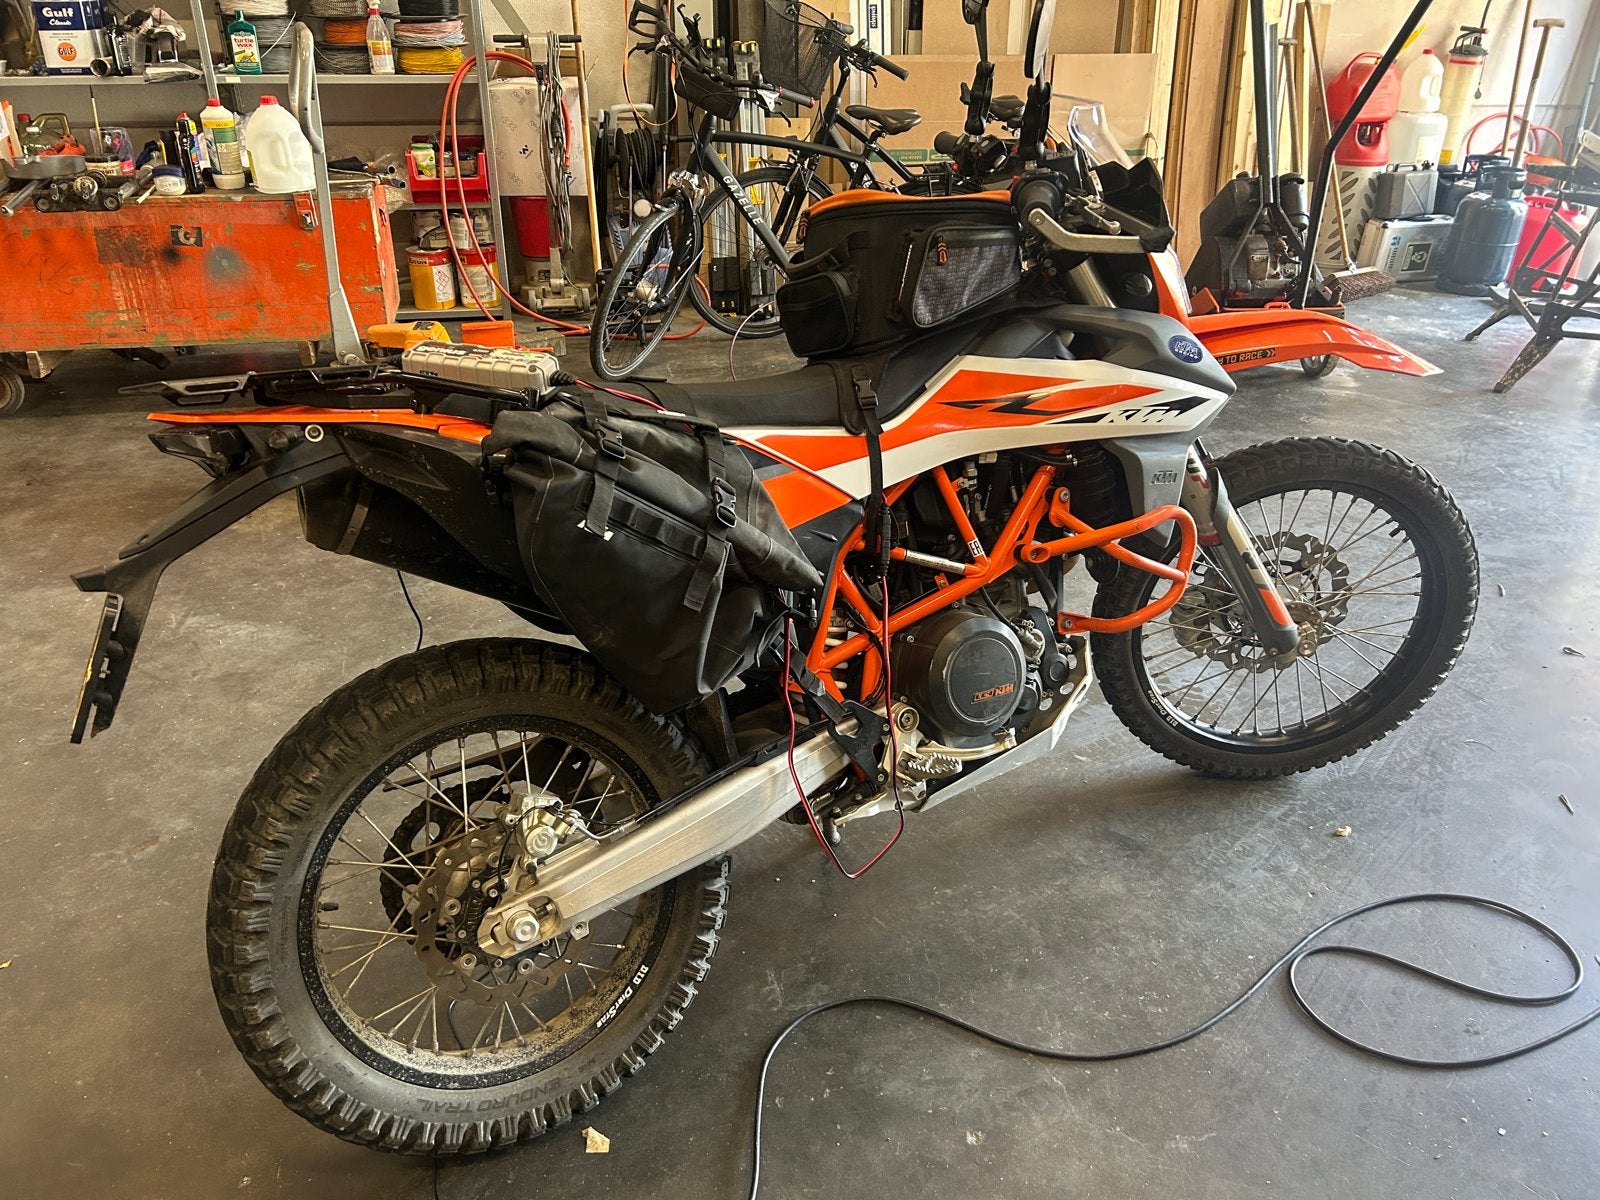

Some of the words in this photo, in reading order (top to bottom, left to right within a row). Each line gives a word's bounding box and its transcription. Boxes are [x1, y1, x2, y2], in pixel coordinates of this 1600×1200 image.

[42, 7, 74, 17] Gulf
[58, 47, 74, 56] GULF
[723, 175, 763, 225] GAZELLE
[1174, 340, 1199, 355] KTM
[1225, 356, 1237, 364] TO
[1239, 350, 1263, 361] RACE
[1097, 406, 1182, 425] KTM
[1150, 470, 1178, 484] KTM
[477, 1077, 561, 1112] ENDURO
[417, 1098, 473, 1114] TRAIL
